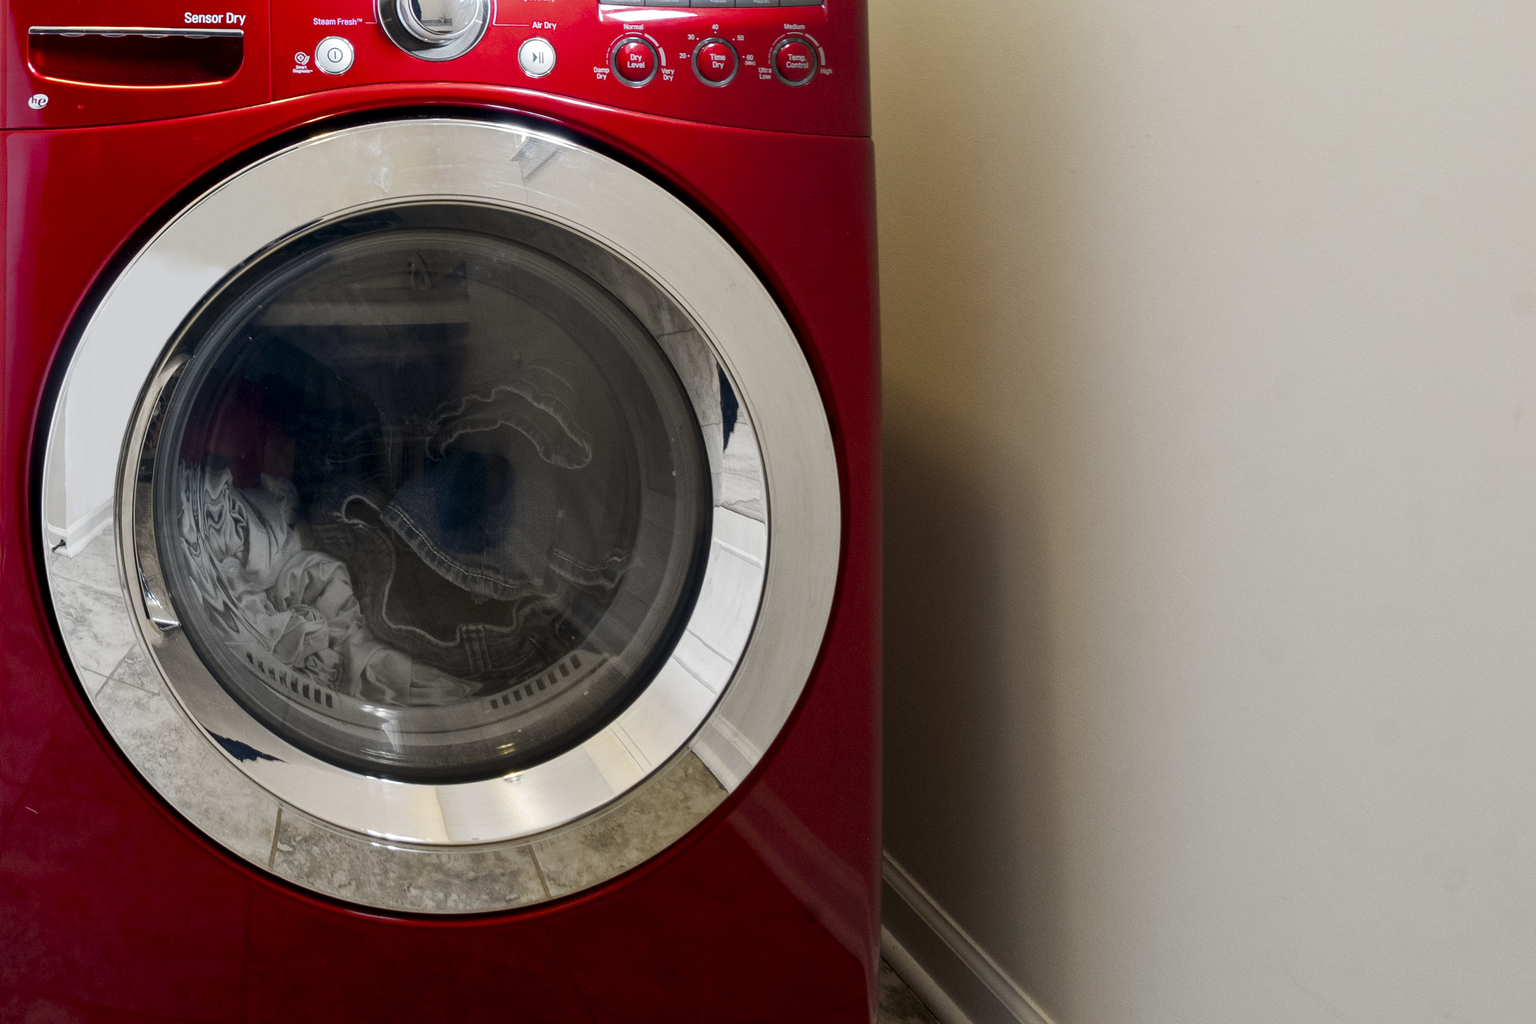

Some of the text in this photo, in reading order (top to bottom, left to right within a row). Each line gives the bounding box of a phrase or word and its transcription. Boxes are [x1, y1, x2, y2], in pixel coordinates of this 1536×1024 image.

[184, 12, 246, 26] Sensor Dry
[532, 21, 557, 30] Air Dry
[630, 54, 642, 62] Dry
[787, 54, 806, 62] Temp.
